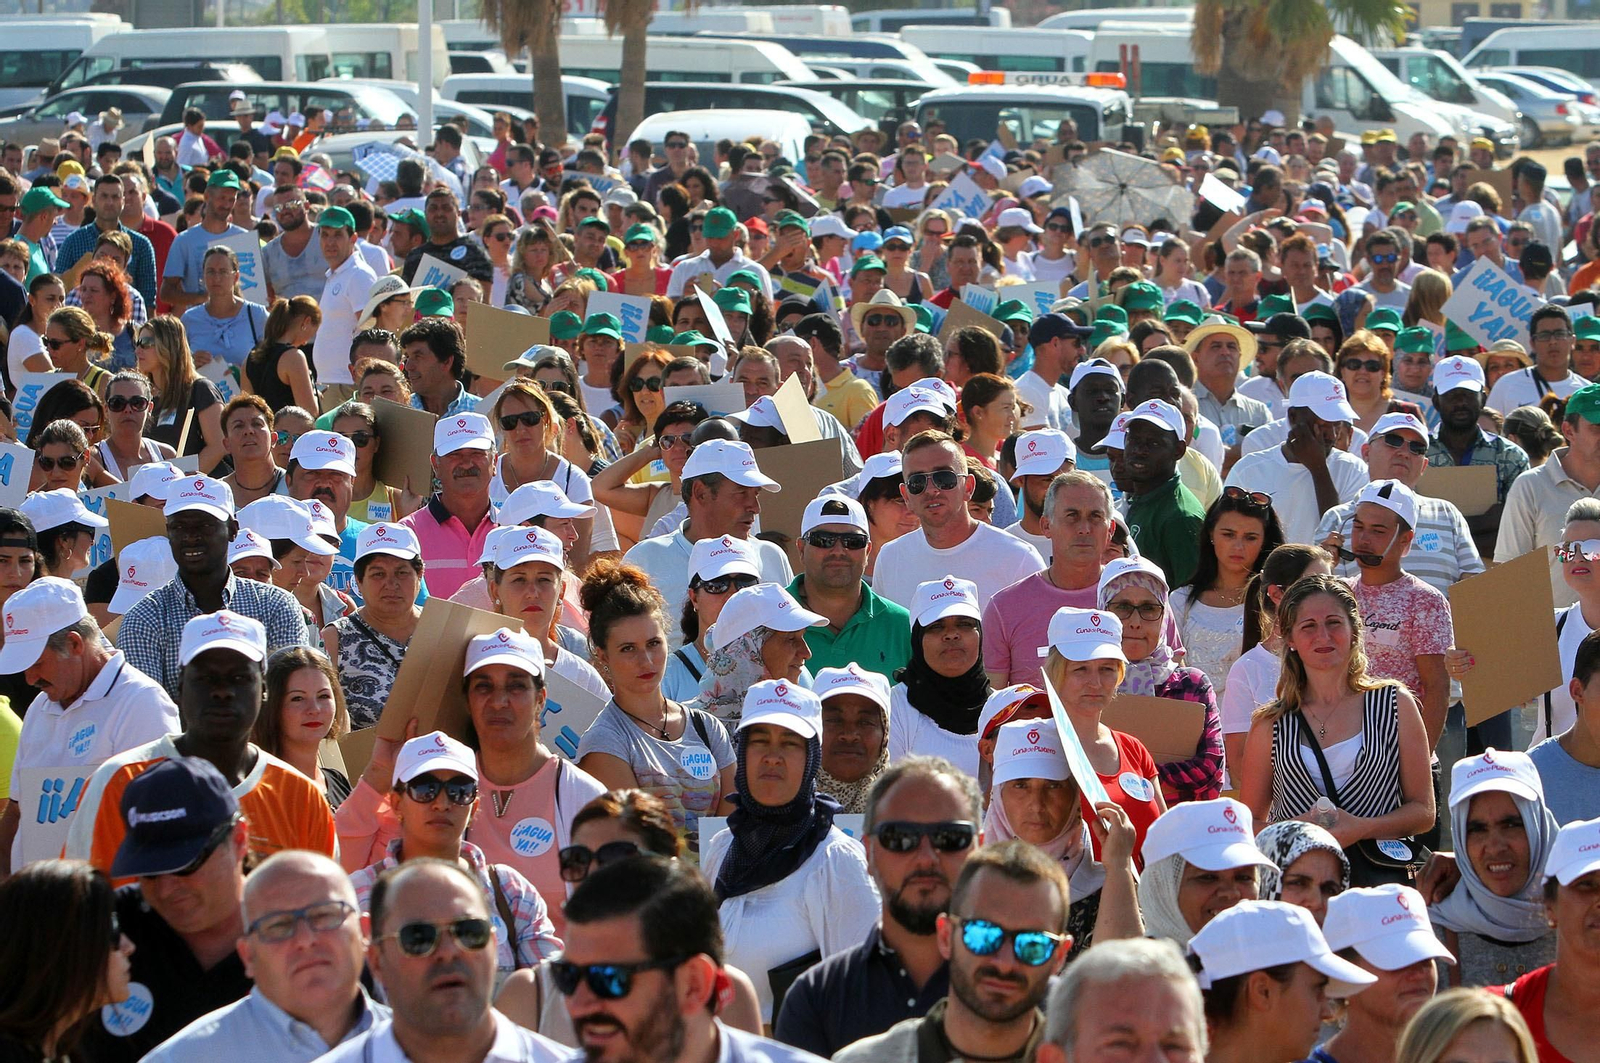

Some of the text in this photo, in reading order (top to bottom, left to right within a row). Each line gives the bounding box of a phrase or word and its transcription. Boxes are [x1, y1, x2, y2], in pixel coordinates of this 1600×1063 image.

[1015, 74, 1072, 85] GRUA
[682, 753, 713, 766] ¡¡AGUA
[691, 765, 709, 777] YA!!
[512, 824, 553, 843] ¡¡AGUA
[515, 838, 540, 853] YA!!
